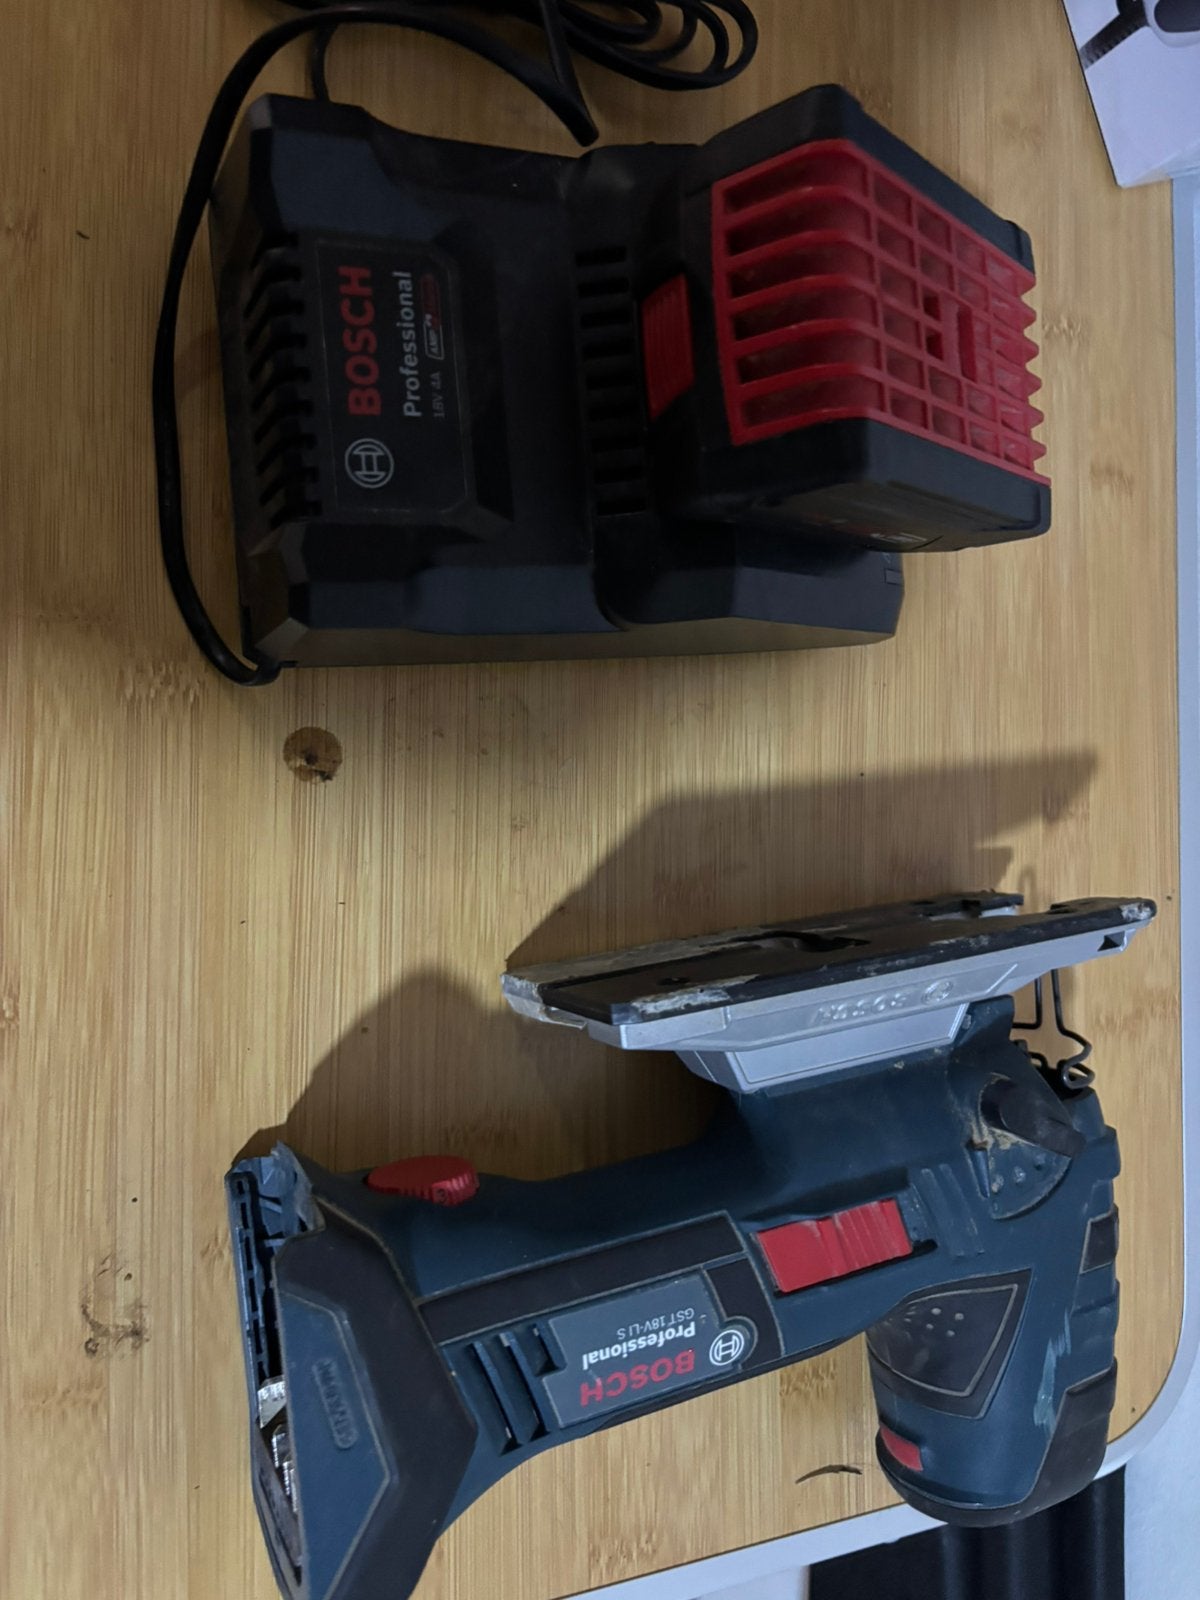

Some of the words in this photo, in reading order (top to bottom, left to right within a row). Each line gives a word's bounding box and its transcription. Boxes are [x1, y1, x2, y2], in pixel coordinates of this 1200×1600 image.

[337, 266, 382, 416] BOSCH
[392, 271, 422, 417] Professional
[432, 394, 445, 418] 18V
[616, 1329, 627, 1340] S
[670, 1308, 695, 1326] GST
[582, 1321, 696, 1370] Professional
[580, 1348, 696, 1407] BOSCH
